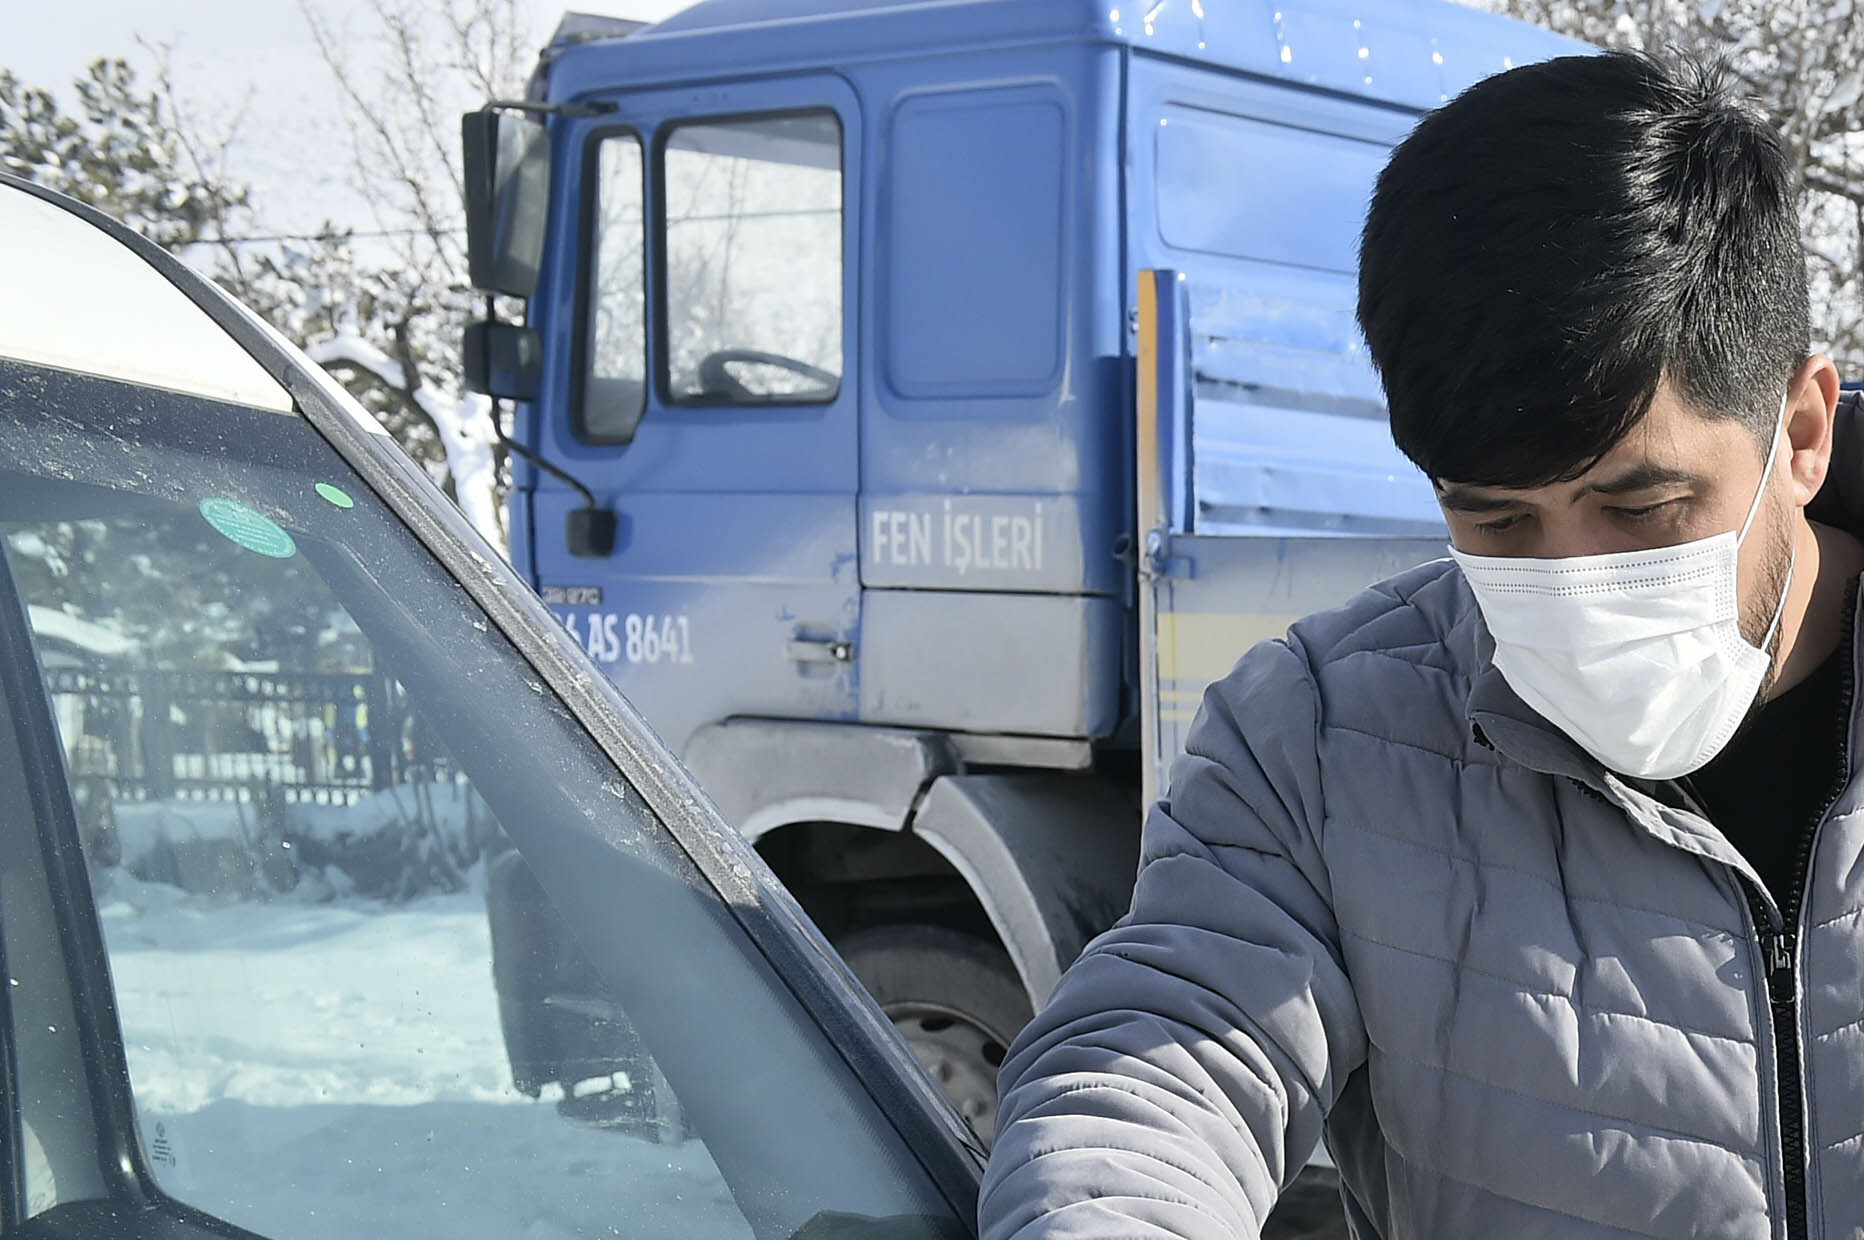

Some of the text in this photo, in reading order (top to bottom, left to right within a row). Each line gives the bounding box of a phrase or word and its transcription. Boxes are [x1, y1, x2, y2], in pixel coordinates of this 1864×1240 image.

[872, 499, 1045, 577] FEN İŞLERİ
[587, 613, 621, 663] AS
[625, 613, 695, 664] 8641
